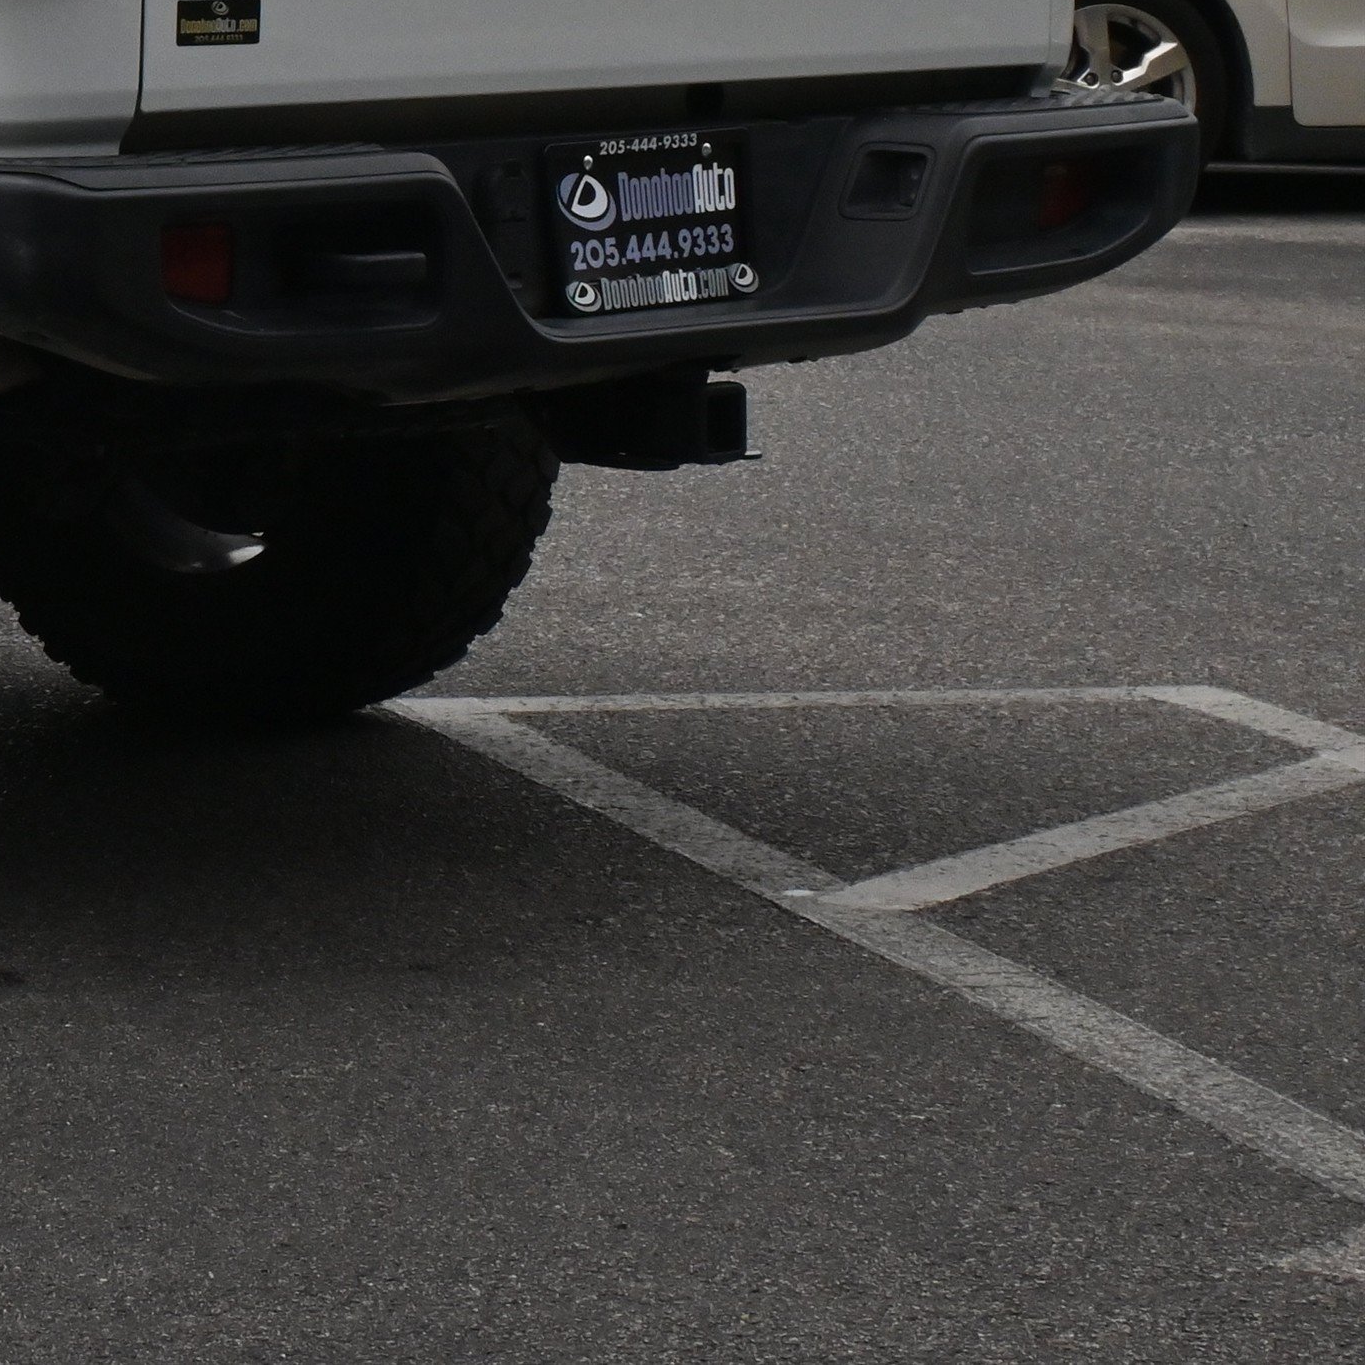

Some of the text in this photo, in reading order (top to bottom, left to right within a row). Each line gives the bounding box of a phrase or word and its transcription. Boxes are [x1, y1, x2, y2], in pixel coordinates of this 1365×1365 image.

[598, 133, 698, 156] 205-444-9333
[617, 162, 736, 222] DonohooAuto
[570, 223, 734, 271] 205.444.9333
